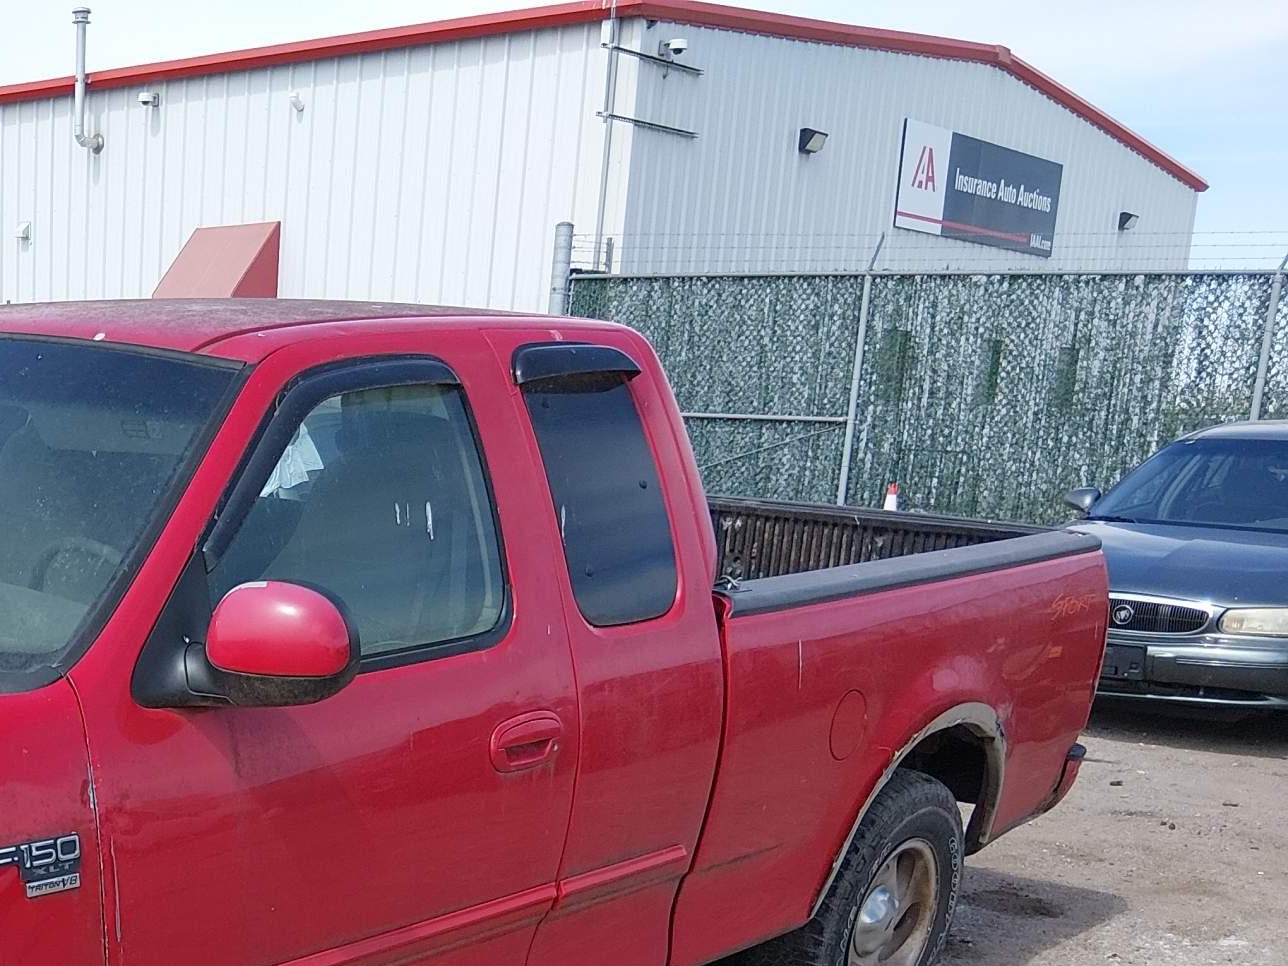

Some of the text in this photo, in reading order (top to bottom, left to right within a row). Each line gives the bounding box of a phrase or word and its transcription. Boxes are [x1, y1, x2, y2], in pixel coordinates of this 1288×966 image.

[954, 167, 1052, 213] Insurance Auto Auctions
[32, 861, 73, 875] XLT
